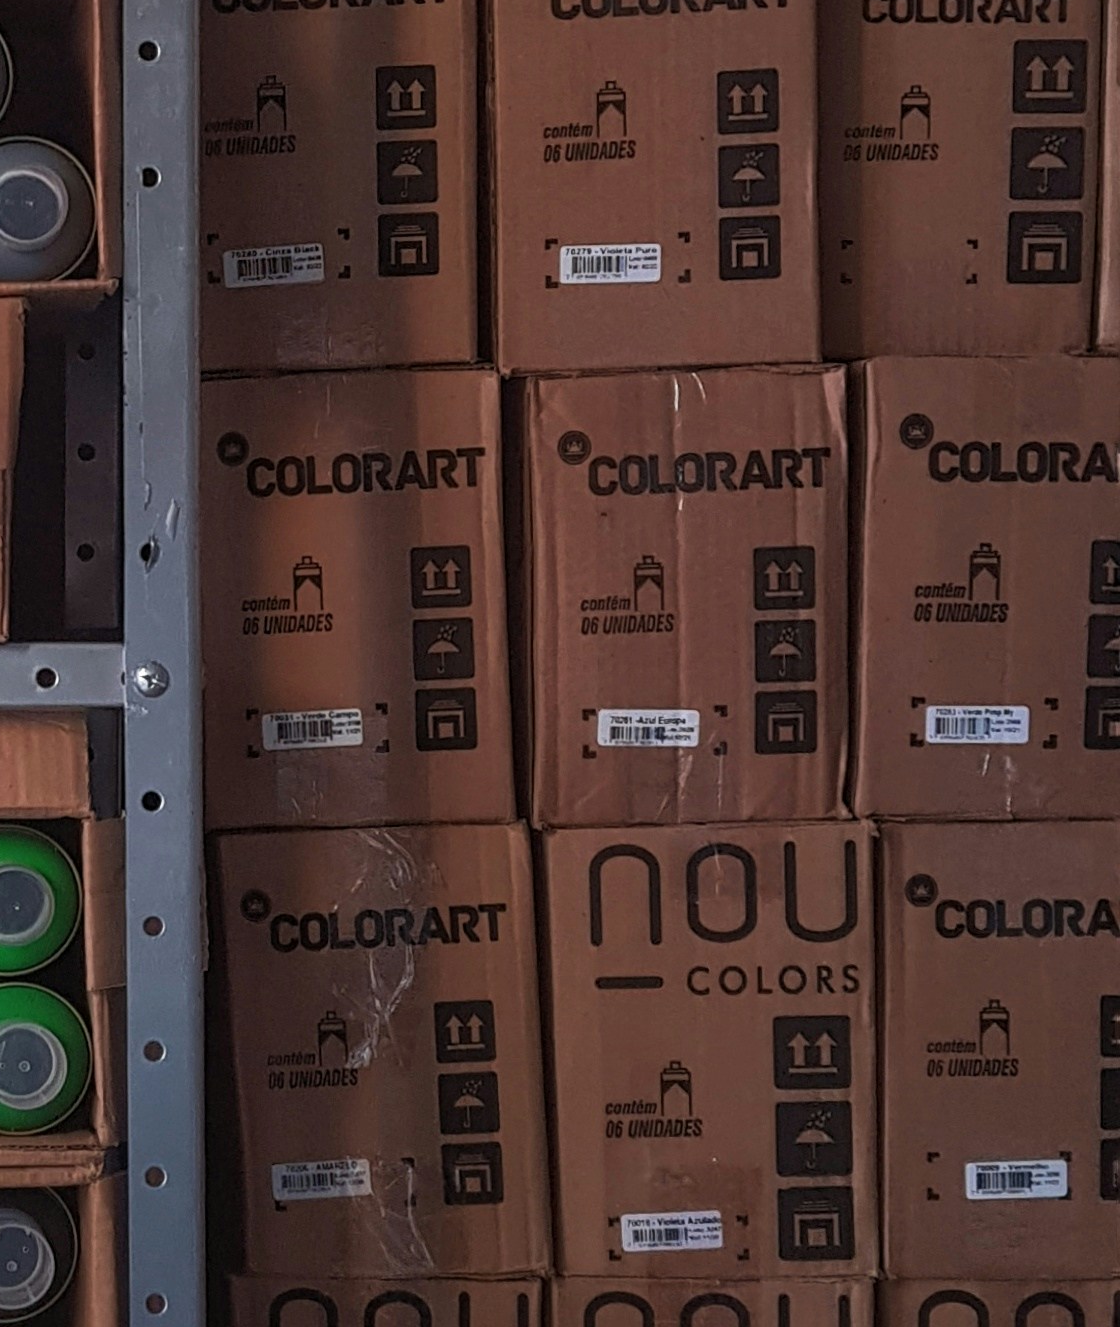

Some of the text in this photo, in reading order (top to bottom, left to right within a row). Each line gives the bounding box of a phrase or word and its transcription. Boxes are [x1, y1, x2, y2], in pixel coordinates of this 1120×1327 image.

[543, 122, 593, 139] contém
[226, 134, 296, 155] UNIDADES
[544, 140, 636, 163] 06 UNIDADES
[866, 143, 939, 162] UNIDADES
[246, 447, 485, 498] COLORART
[588, 447, 830, 496] COLORART
[914, 582, 966, 598] contém
[242, 596, 290, 612] contém
[580, 595, 630, 611] contém
[914, 602, 1009, 623] 06 UNIDADES
[242, 613, 333, 635] 06 UNIDADES
[581, 613, 674, 635] 06 UNIDADES
[328, 711, 358, 719] Campo
[270, 903, 507, 953] COLORART
[686, 964, 860, 995] COLORS
[927, 1039, 976, 1053] contém
[927, 1058, 1019, 1077] 06 UNIDADES
[289, 1069, 358, 1088] UNIDADES
[605, 1099, 657, 1115] contém
[605, 1118, 702, 1138] 06 UNIDADES
